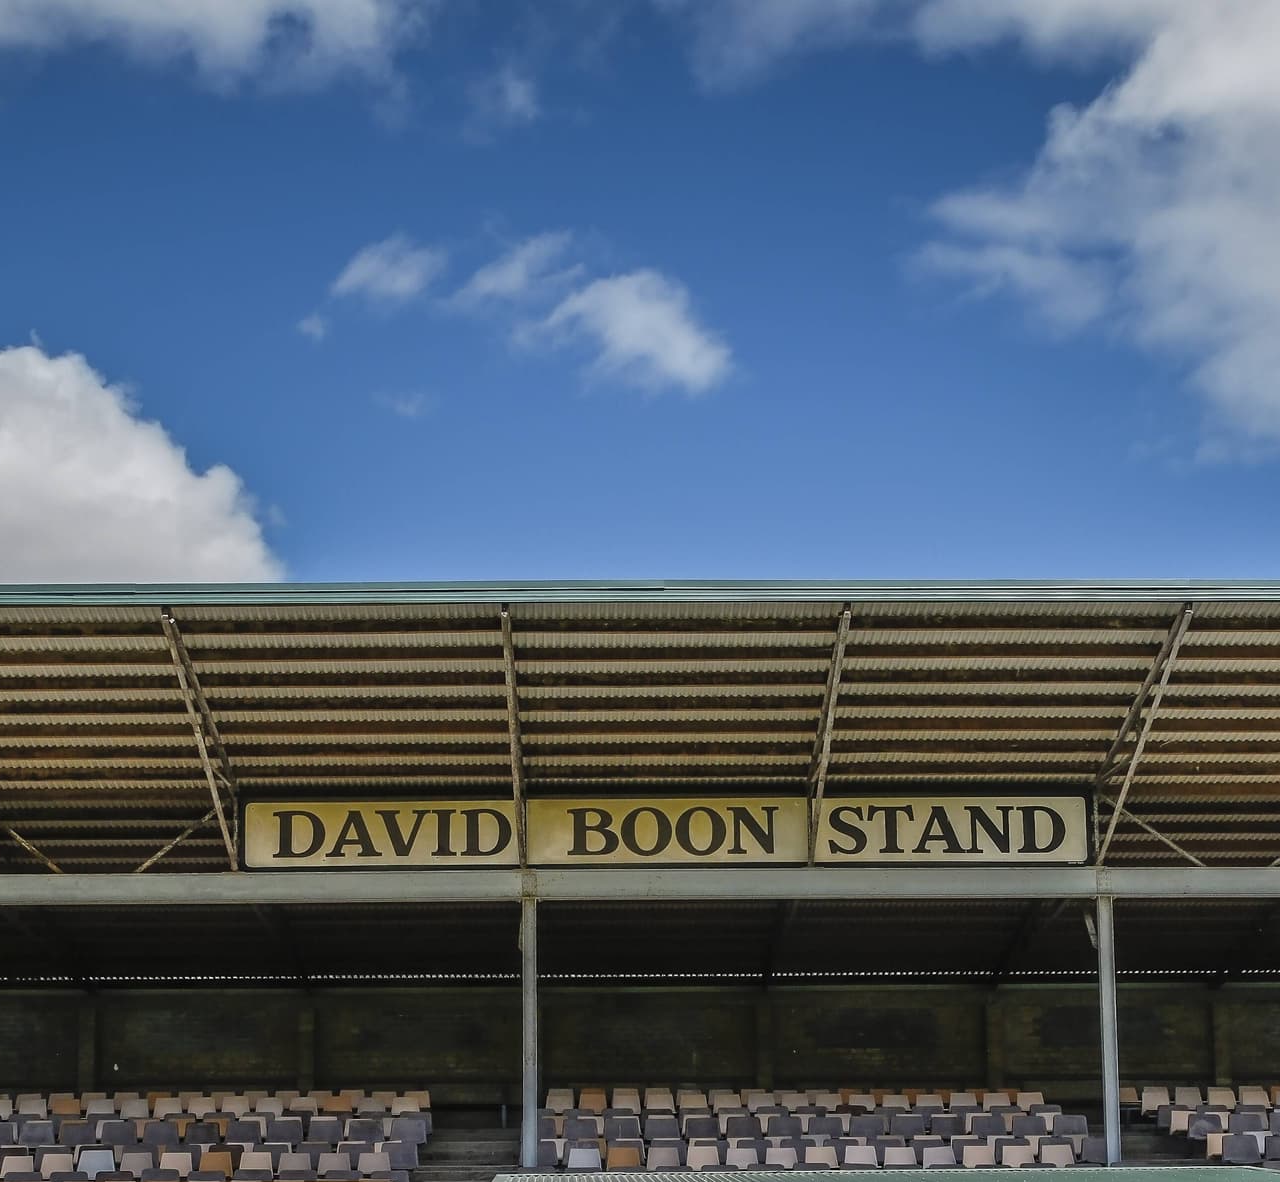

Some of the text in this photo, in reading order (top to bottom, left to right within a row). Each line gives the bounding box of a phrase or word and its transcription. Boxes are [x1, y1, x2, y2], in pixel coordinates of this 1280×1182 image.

[272, 804, 1066, 858] DAVID BOON STAND
